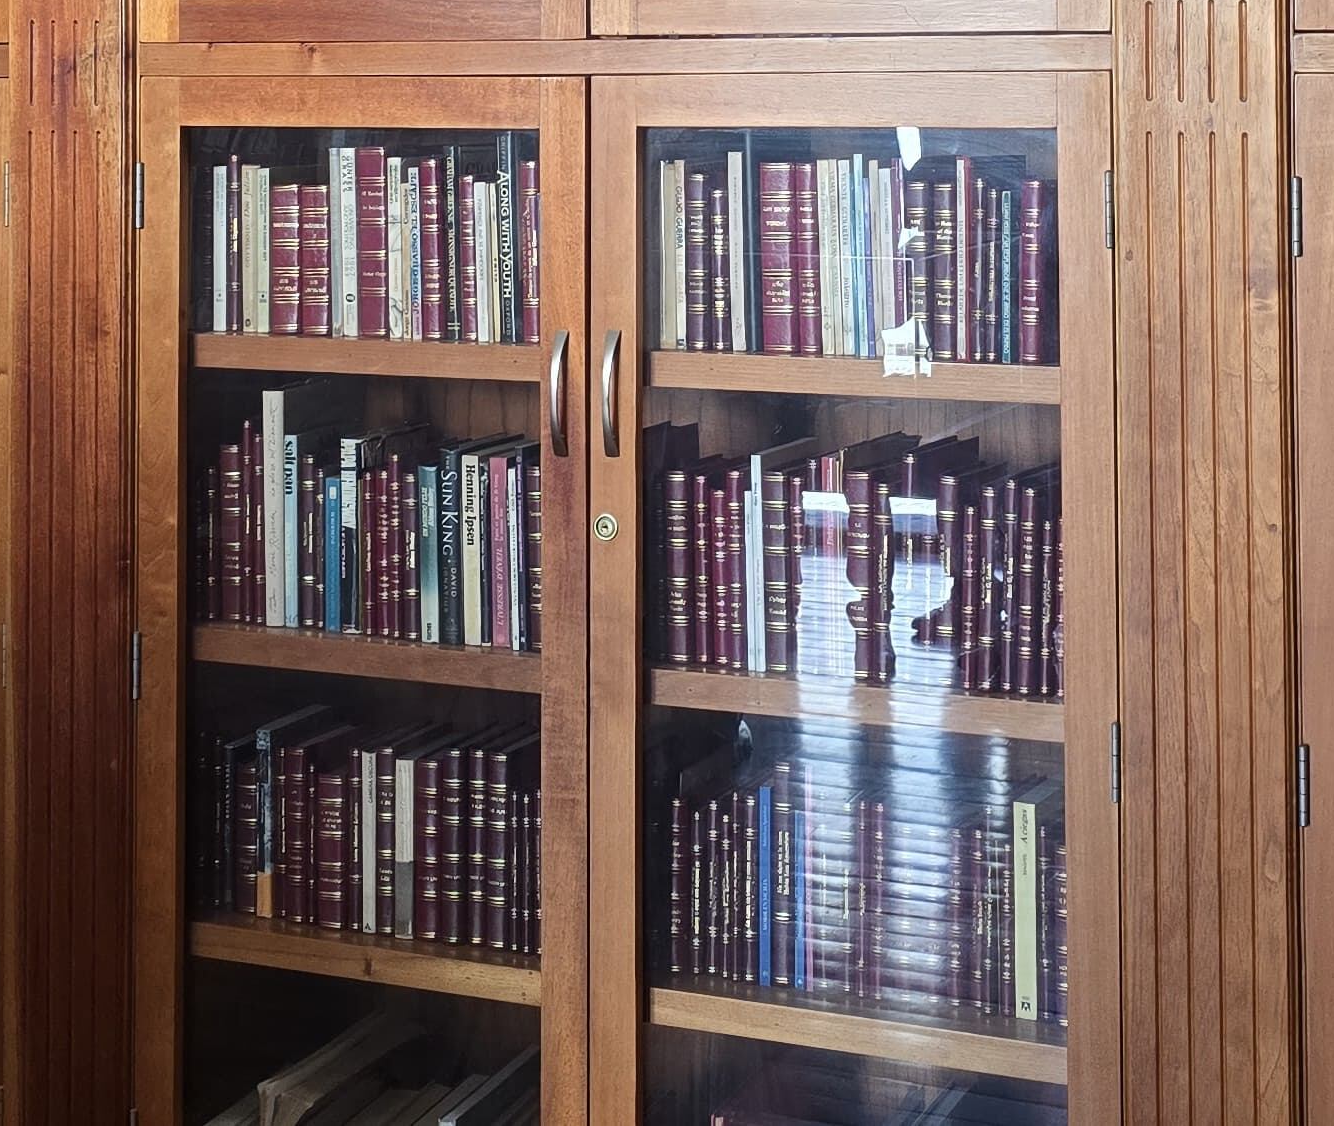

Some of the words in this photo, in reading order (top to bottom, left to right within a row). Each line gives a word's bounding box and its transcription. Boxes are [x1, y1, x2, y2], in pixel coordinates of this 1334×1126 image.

[496, 170, 510, 217] ALONG
[500, 218, 510, 253] WITH
[499, 252, 512, 299] YOUTH
[440, 470, 459, 506] SUN
[464, 464, 477, 513] Henning
[440, 510, 459, 556] KING
[464, 515, 477, 546] Ipsen
[495, 583, 505, 626] L'IVRESSE
[1020, 808, 1029, 835] ciegas
